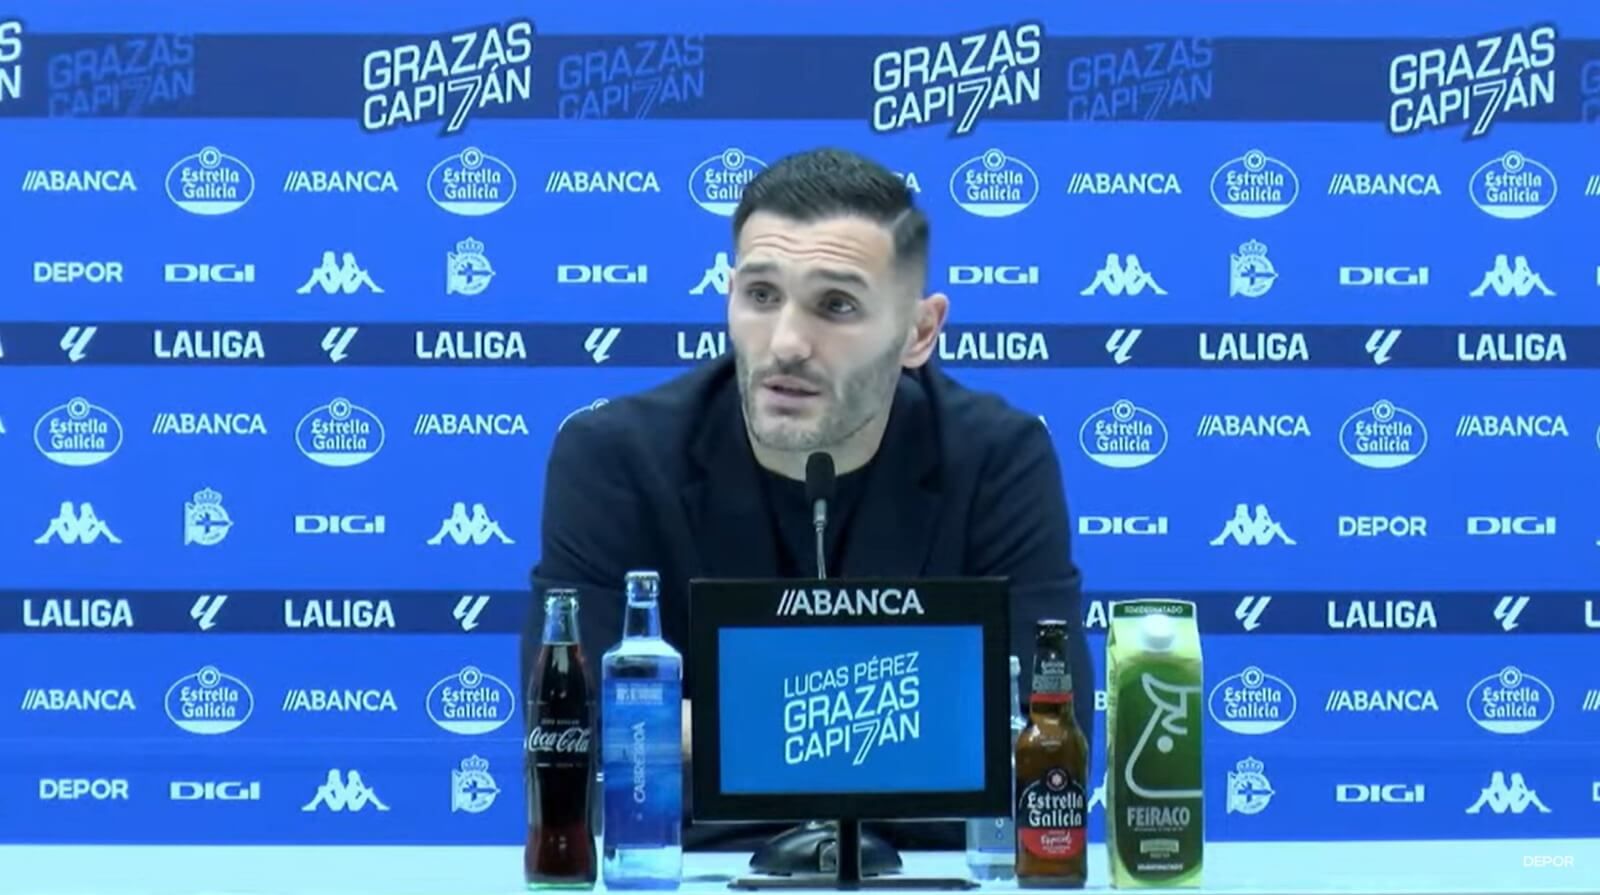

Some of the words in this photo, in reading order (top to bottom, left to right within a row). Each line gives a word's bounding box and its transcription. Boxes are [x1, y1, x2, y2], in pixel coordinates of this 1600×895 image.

[50, 33, 194, 90] GRAZAS
[364, 23, 531, 91] GRAZAS
[559, 33, 704, 90] GRAZAS
[874, 25, 1040, 92] GRAZAS
[1068, 36, 1214, 92] GRAZAS
[1390, 28, 1554, 94] GRAZAS
[364, 63, 530, 131] CAPI7ÁN
[874, 65, 1039, 133] CAPI7ÁN
[1391, 67, 1554, 135] CAPI7ÁN
[181, 167, 239, 183] Estrella
[443, 167, 500, 183] Estrella
[704, 168, 759, 184] Estrell
[966, 169, 1023, 185] Estrella
[1227, 170, 1283, 186] Estrella
[1486, 171, 1541, 187] Estrella
[183, 182, 236, 198] Galicia
[445, 182, 497, 198] Galicia
[706, 184, 743, 200] Gali
[968, 184, 1020, 200] Galicia
[1228, 185, 1280, 201] Galicia
[1487, 186, 1538, 202] Galicia
[34, 262, 122, 282] DEPOR
[165, 264, 255, 282] DIGI
[558, 265, 647, 283] DIGI
[949, 266, 1038, 284] DIGI
[1340, 267, 1428, 285] DIGI
[155, 330, 264, 358] LALIGA
[416, 331, 526, 359] LALIGA
[678, 332, 726, 359] LAL
[939, 332, 1048, 360] LALIGA
[1200, 333, 1308, 360] LALIGA
[1459, 333, 1566, 361] LALIGA
[50, 417, 107, 433] Estrella
[312, 418, 369, 434] Estrella
[1096, 420, 1152, 436] Estrella
[1355, 420, 1411, 436] Estrella
[52, 432, 104, 448] Galicia
[314, 433, 366, 449] Galicia
[1098, 435, 1149, 451] Galicia
[1357, 435, 1409, 451] Galicia
[296, 516, 385, 533] DIGI
[1079, 517, 1167, 534] DIGI
[1339, 516, 1426, 536] DEPOR
[1468, 517, 1555, 534] DIGI
[24, 600, 133, 627] LALIGA
[285, 600, 395, 627] LALIGA
[1329, 601, 1436, 628] LALIGA
[785, 666, 848, 697] LUCAS
[855, 652, 919, 684] PÉREZ
[180, 686, 237, 702] Estrella
[442, 686, 499, 702] Estrella
[1224, 686, 1280, 702] Estrella
[1482, 686, 1538, 702] Estrella
[183, 701, 235, 717] Galicia
[444, 701, 496, 717] Galicia
[785, 676, 919, 733] GRAZAS
[1226, 701, 1278, 717] Galicia
[1484, 701, 1536, 717] Galicia
[785, 709, 919, 765] CAPI7ÁN
[40, 779, 128, 799] DEPOR
[171, 782, 260, 799] DIGI
[1337, 785, 1424, 802] DIGI
[1027, 791, 1083, 809] Estrella
[1028, 809, 1082, 827] Galicia
[1127, 806, 1190, 827] FEIRACO
